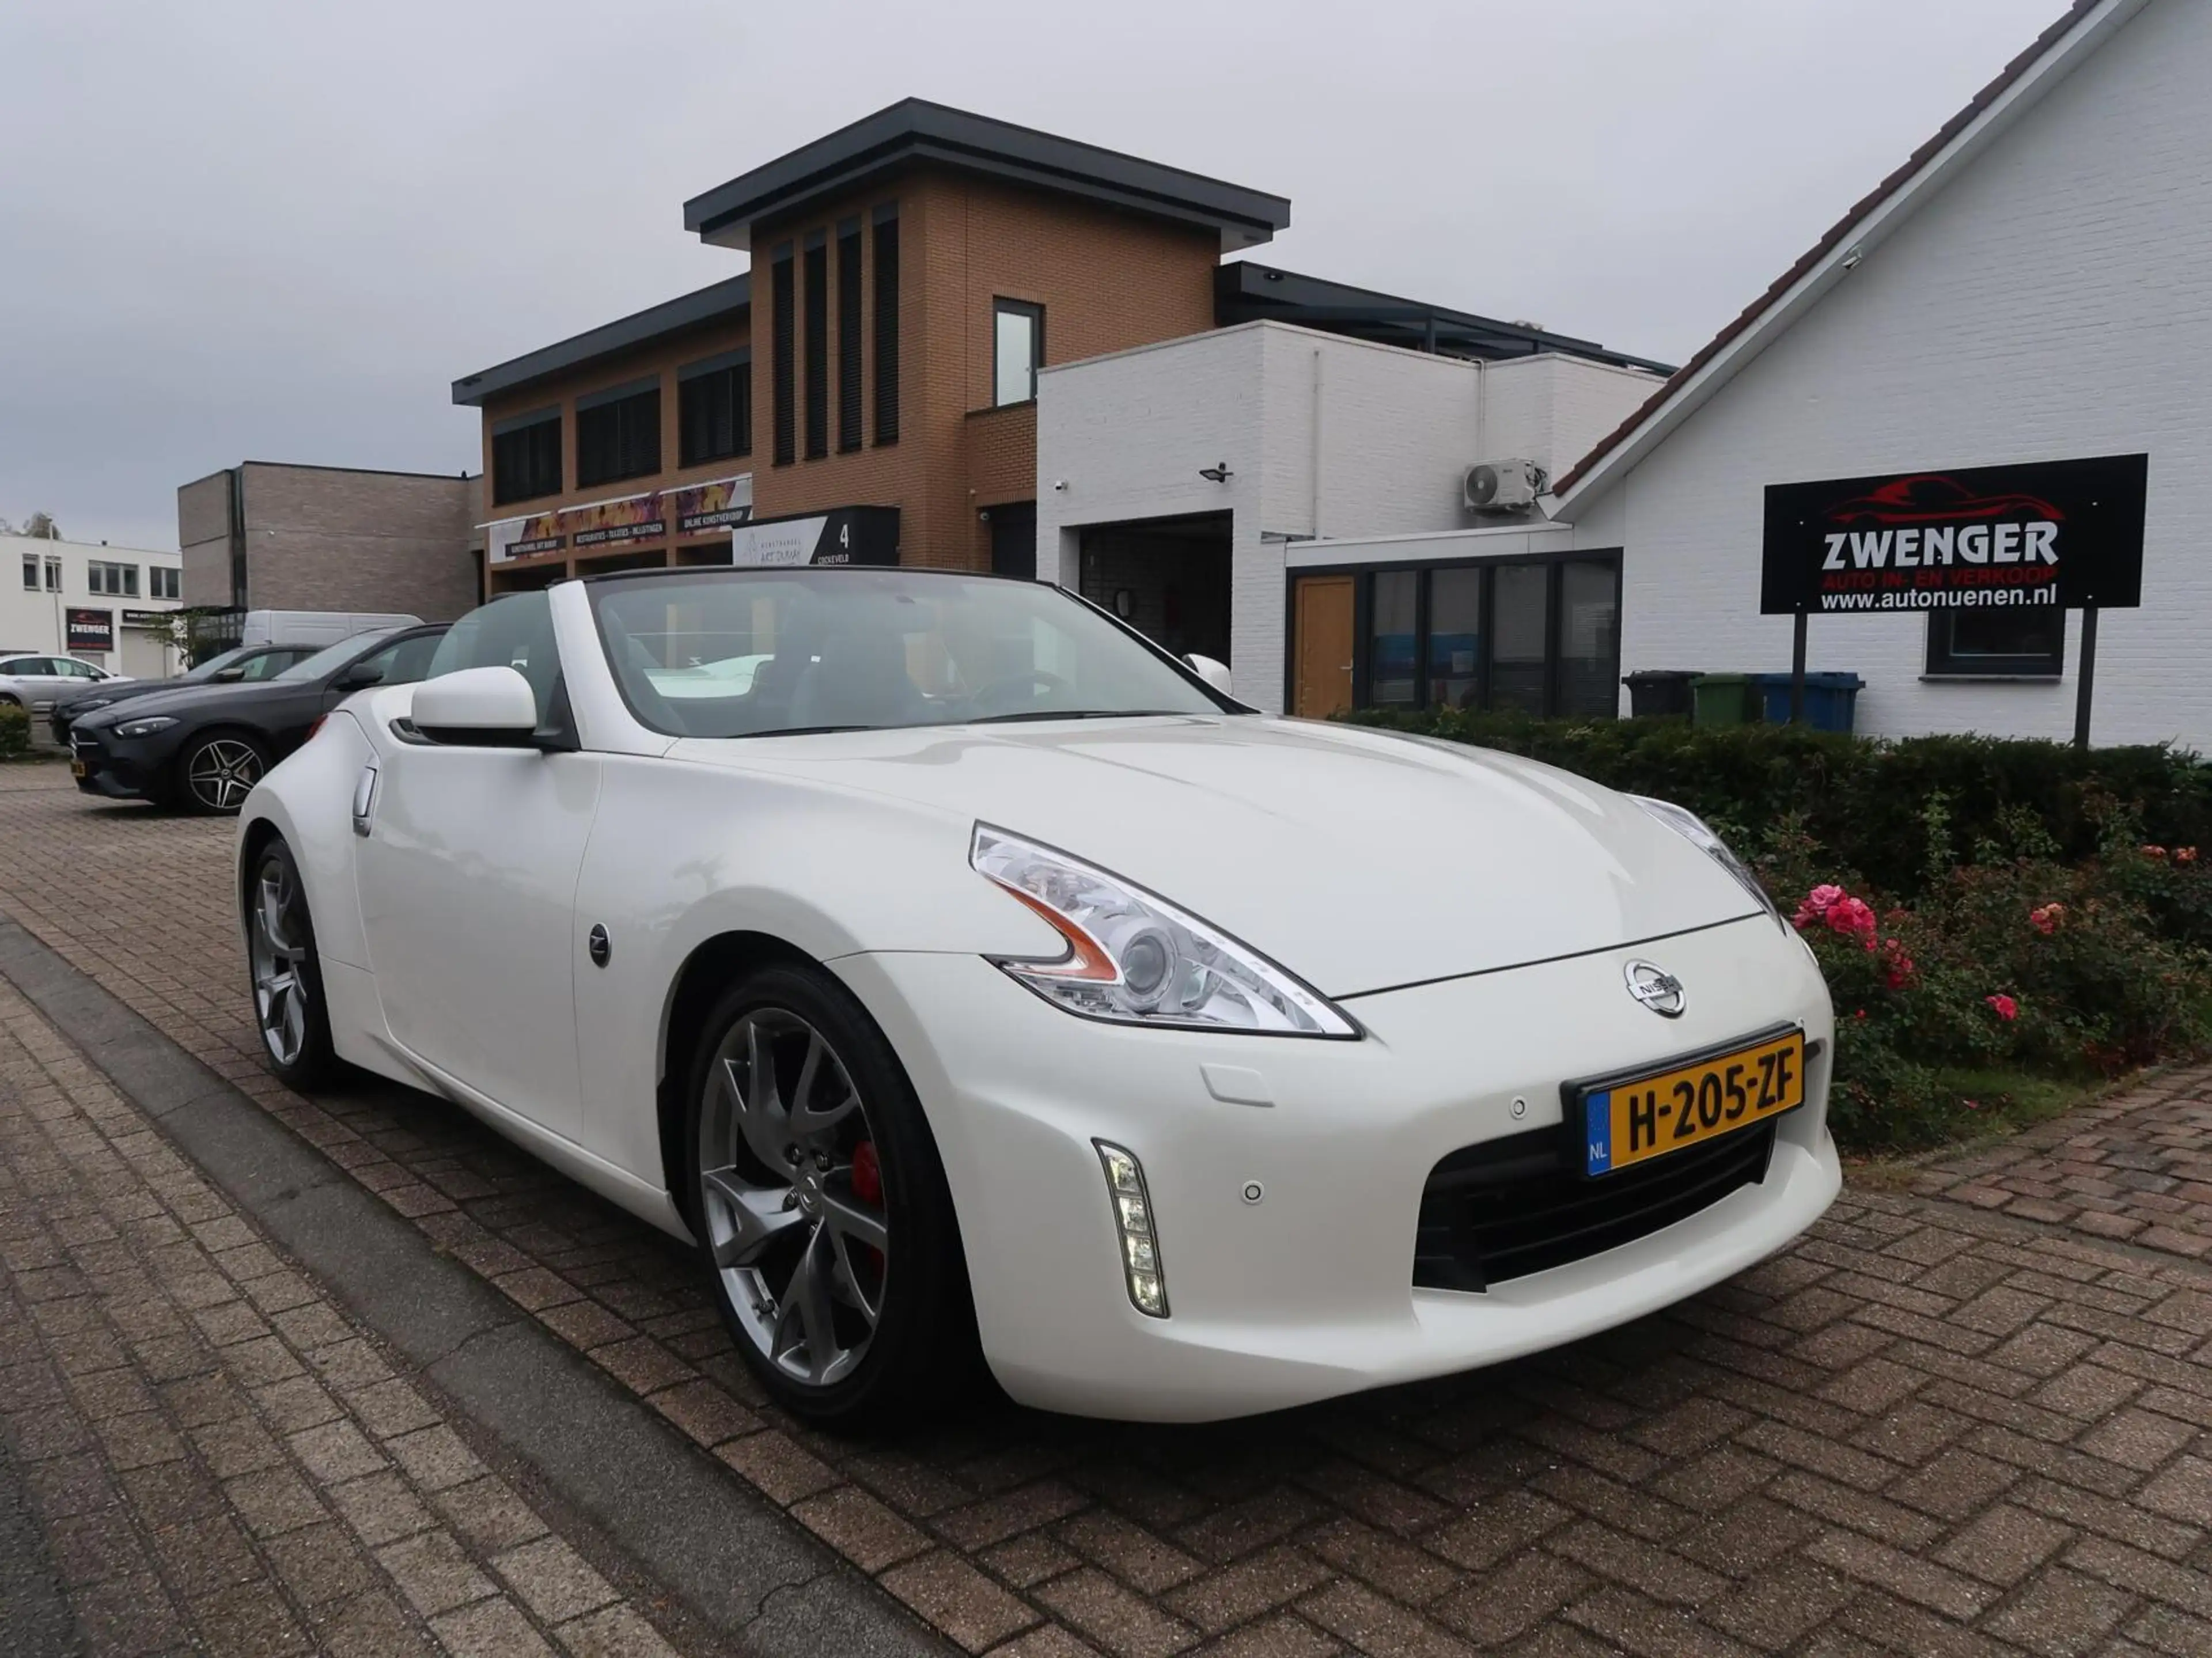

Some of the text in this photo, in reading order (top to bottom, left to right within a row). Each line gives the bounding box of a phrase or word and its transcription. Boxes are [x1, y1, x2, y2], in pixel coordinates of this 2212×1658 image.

[839, 523, 849, 548] 4
[1822, 521, 2059, 570] ZWENGER
[1822, 572, 1876, 590] AUTO
[1917, 570, 1944, 588] EN
[1951, 567, 2058, 586] VERKOOP
[1821, 583, 2057, 610] www.autonuenen.nl
[1630, 1046, 1794, 1151] H-205-ZF
[1589, 1141, 1608, 1161] NL
